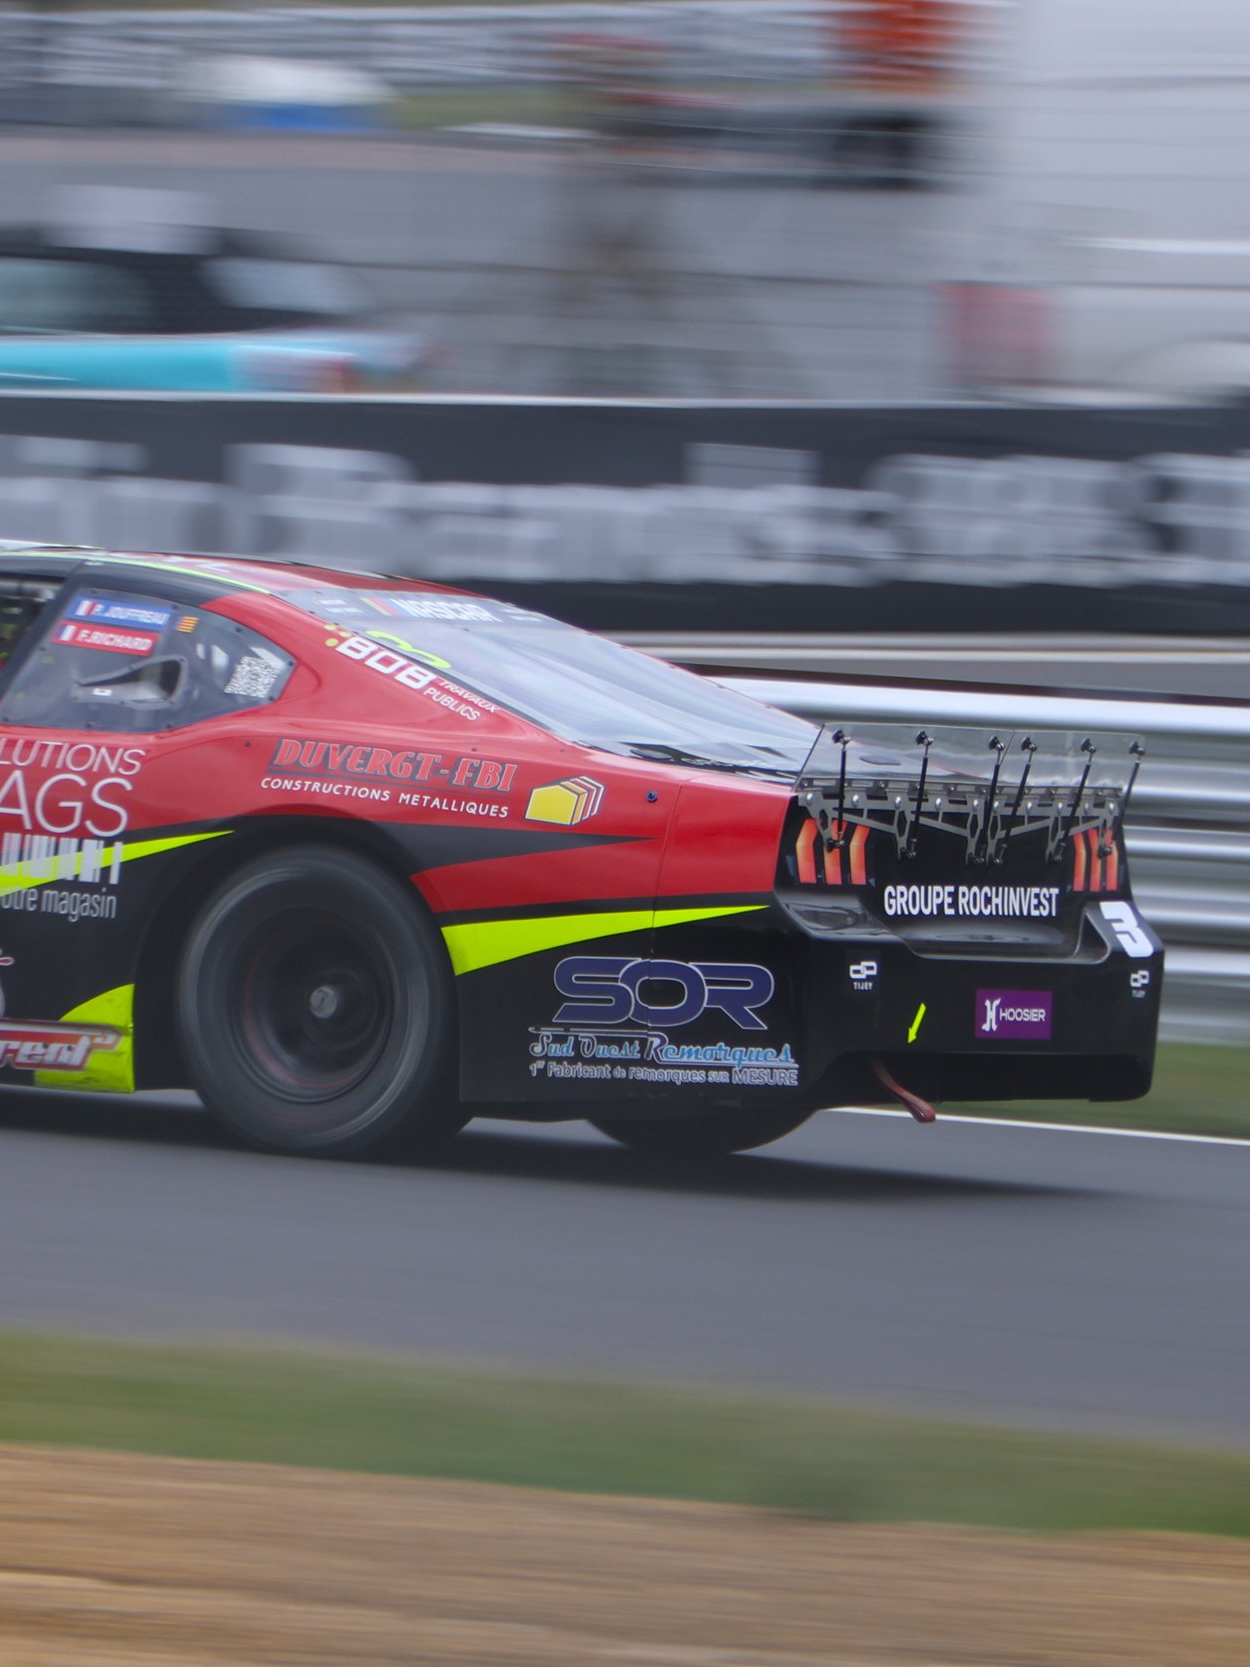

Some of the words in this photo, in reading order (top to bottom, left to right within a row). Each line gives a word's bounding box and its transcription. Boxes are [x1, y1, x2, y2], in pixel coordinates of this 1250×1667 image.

[335, 636, 437, 689] BOB
[436, 678, 500, 713] TRAVAUX
[423, 686, 482, 721] PUBLICS
[260, 777, 391, 802] CONSTRUCTIONS
[398, 792, 509, 819] METALLIQUES
[40, 887, 118, 922] magasin
[884, 885, 955, 916] GROUPE
[958, 886, 1060, 917] ROCHINVEST
[1100, 901, 1154, 957] 3
[553, 956, 775, 1030] SOR
[999, 1008, 1046, 1022] HOOSIER
[529, 1032, 575, 1057] Sud
[578, 1033, 641, 1058] Ouest
[644, 1031, 795, 1068] Remorques
[547, 1061, 611, 1080] Fabricant
[628, 1066, 707, 1085] remorques
[732, 1067, 799, 1086] MESURE
